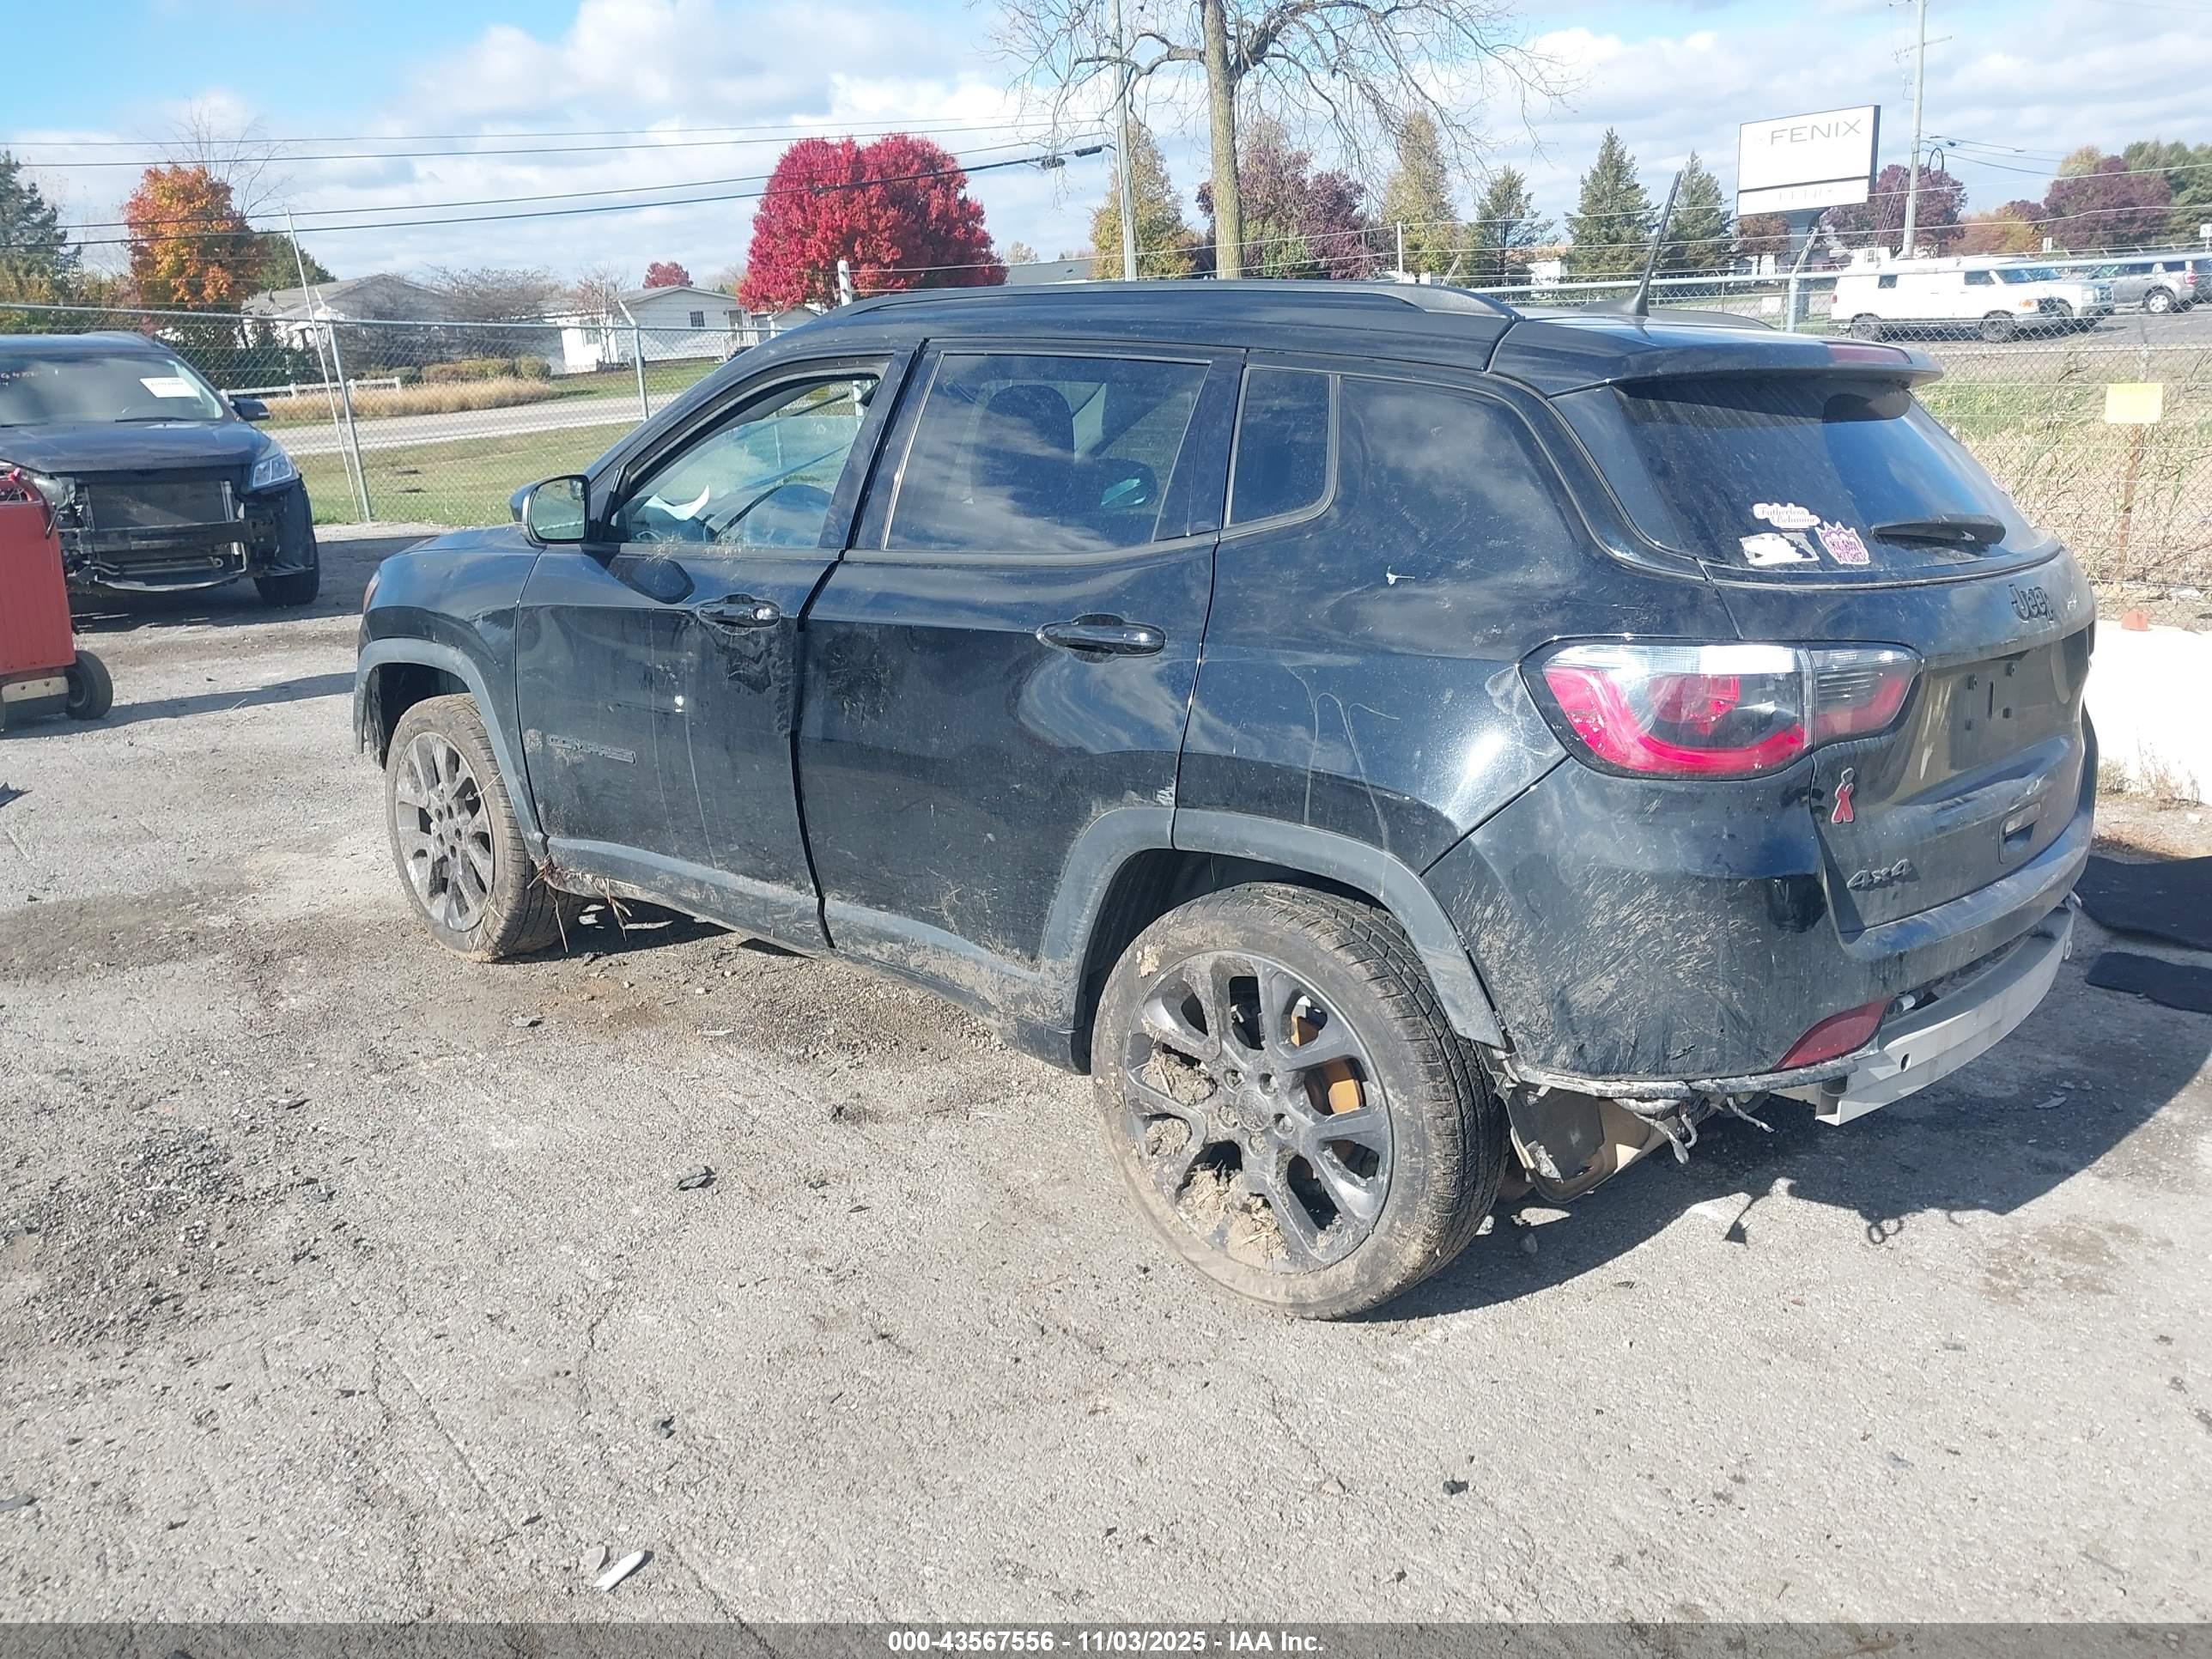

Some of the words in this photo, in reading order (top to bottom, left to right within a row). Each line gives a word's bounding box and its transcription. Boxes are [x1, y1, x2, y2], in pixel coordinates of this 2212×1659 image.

[1771, 118, 1861, 145] FENIX
[2008, 584, 2054, 622] Jeep
[1847, 859, 1912, 888] 4x4
